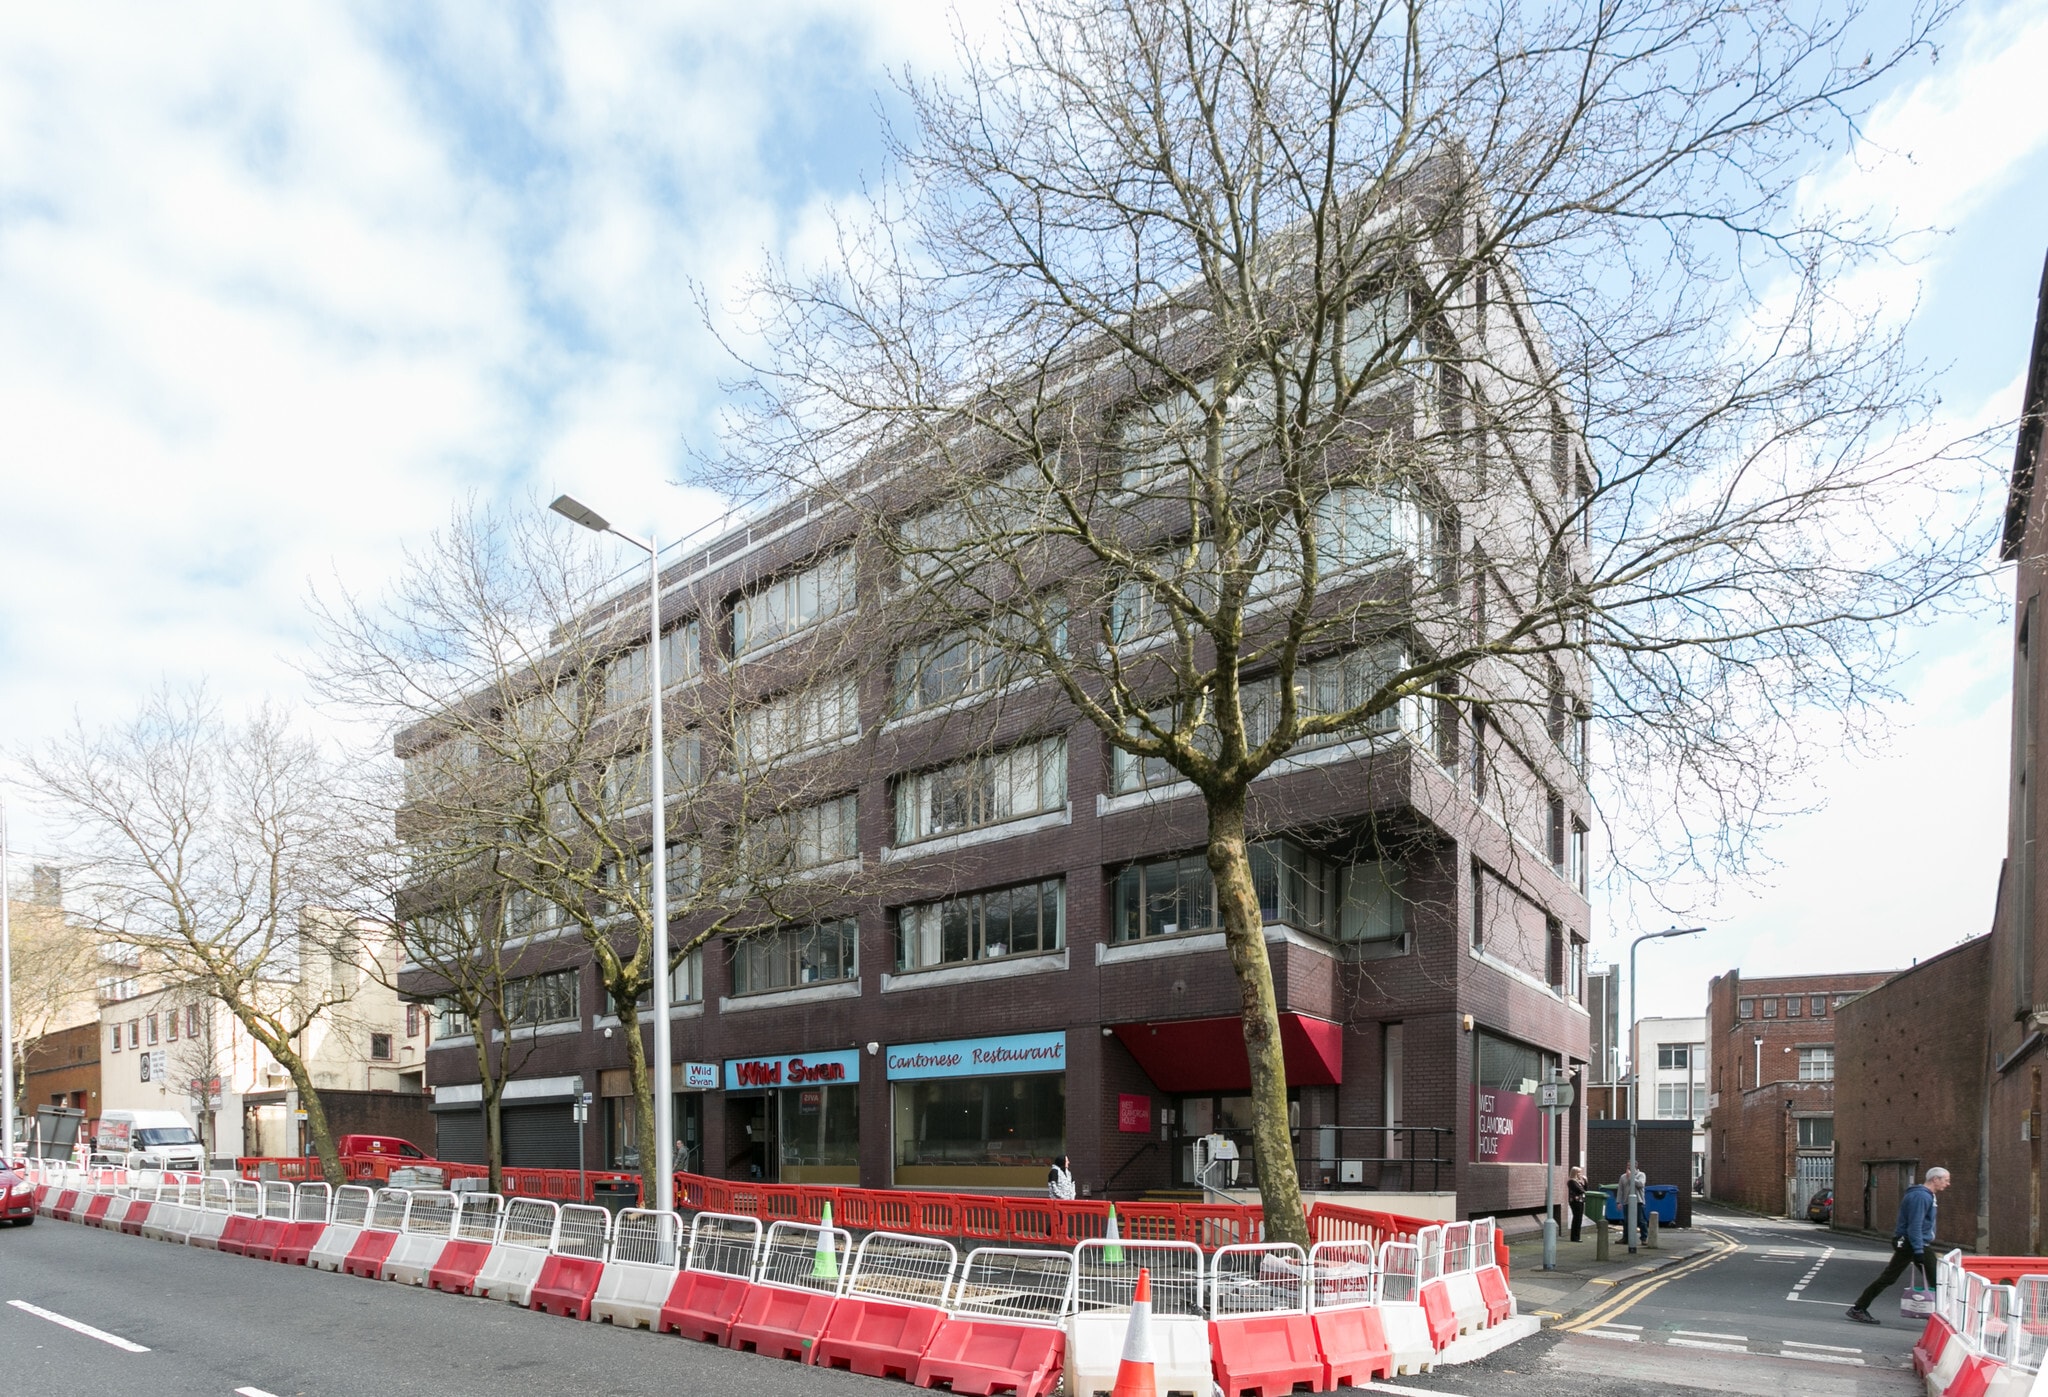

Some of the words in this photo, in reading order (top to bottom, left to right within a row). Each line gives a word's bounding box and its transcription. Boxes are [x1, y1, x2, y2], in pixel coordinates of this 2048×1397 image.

[888, 1052, 962, 1069] Cantonese
[972, 1042, 1063, 1064] Restaurant
[691, 1066, 711, 1075] Wild
[736, 1061, 781, 1086] Wild
[787, 1058, 845, 1082] Swan
[689, 1076, 713, 1086] Swan
[1121, 1101, 1133, 1109] WEST
[1480, 1094, 1495, 1112] WEST
[1121, 1109, 1148, 1118] GLAMORGAN
[1121, 1117, 1136, 1125] HOUSE
[1480, 1115, 1513, 1135] GLAMORGAN
[1480, 1136, 1498, 1154] HOUSE
